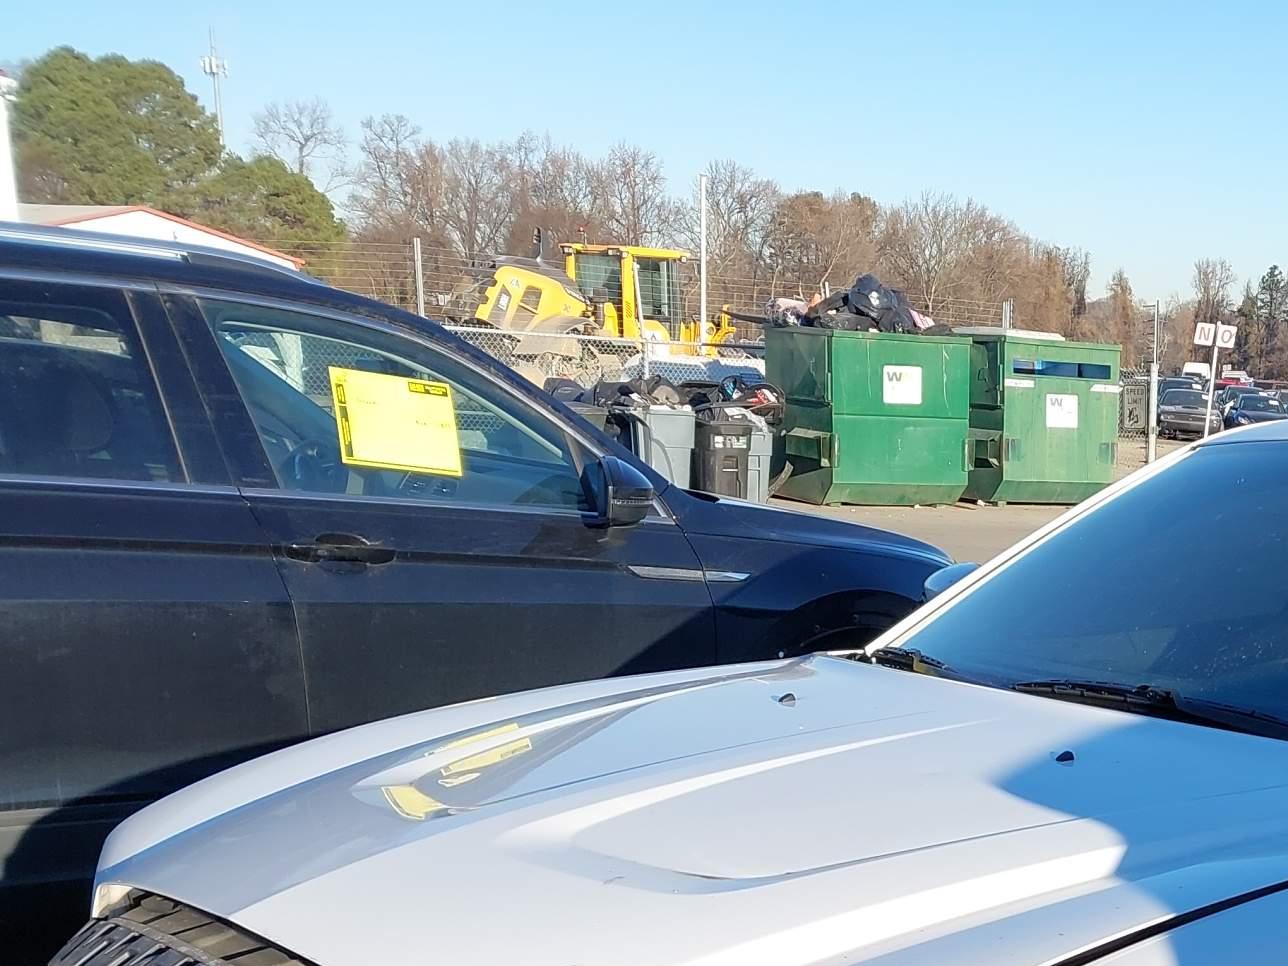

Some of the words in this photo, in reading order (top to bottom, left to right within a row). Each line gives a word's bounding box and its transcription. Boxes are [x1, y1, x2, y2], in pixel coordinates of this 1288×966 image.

[1198, 326, 1211, 341] N
[1125, 387, 1145, 396] SPEED
[1127, 397, 1142, 405] LIMIT
